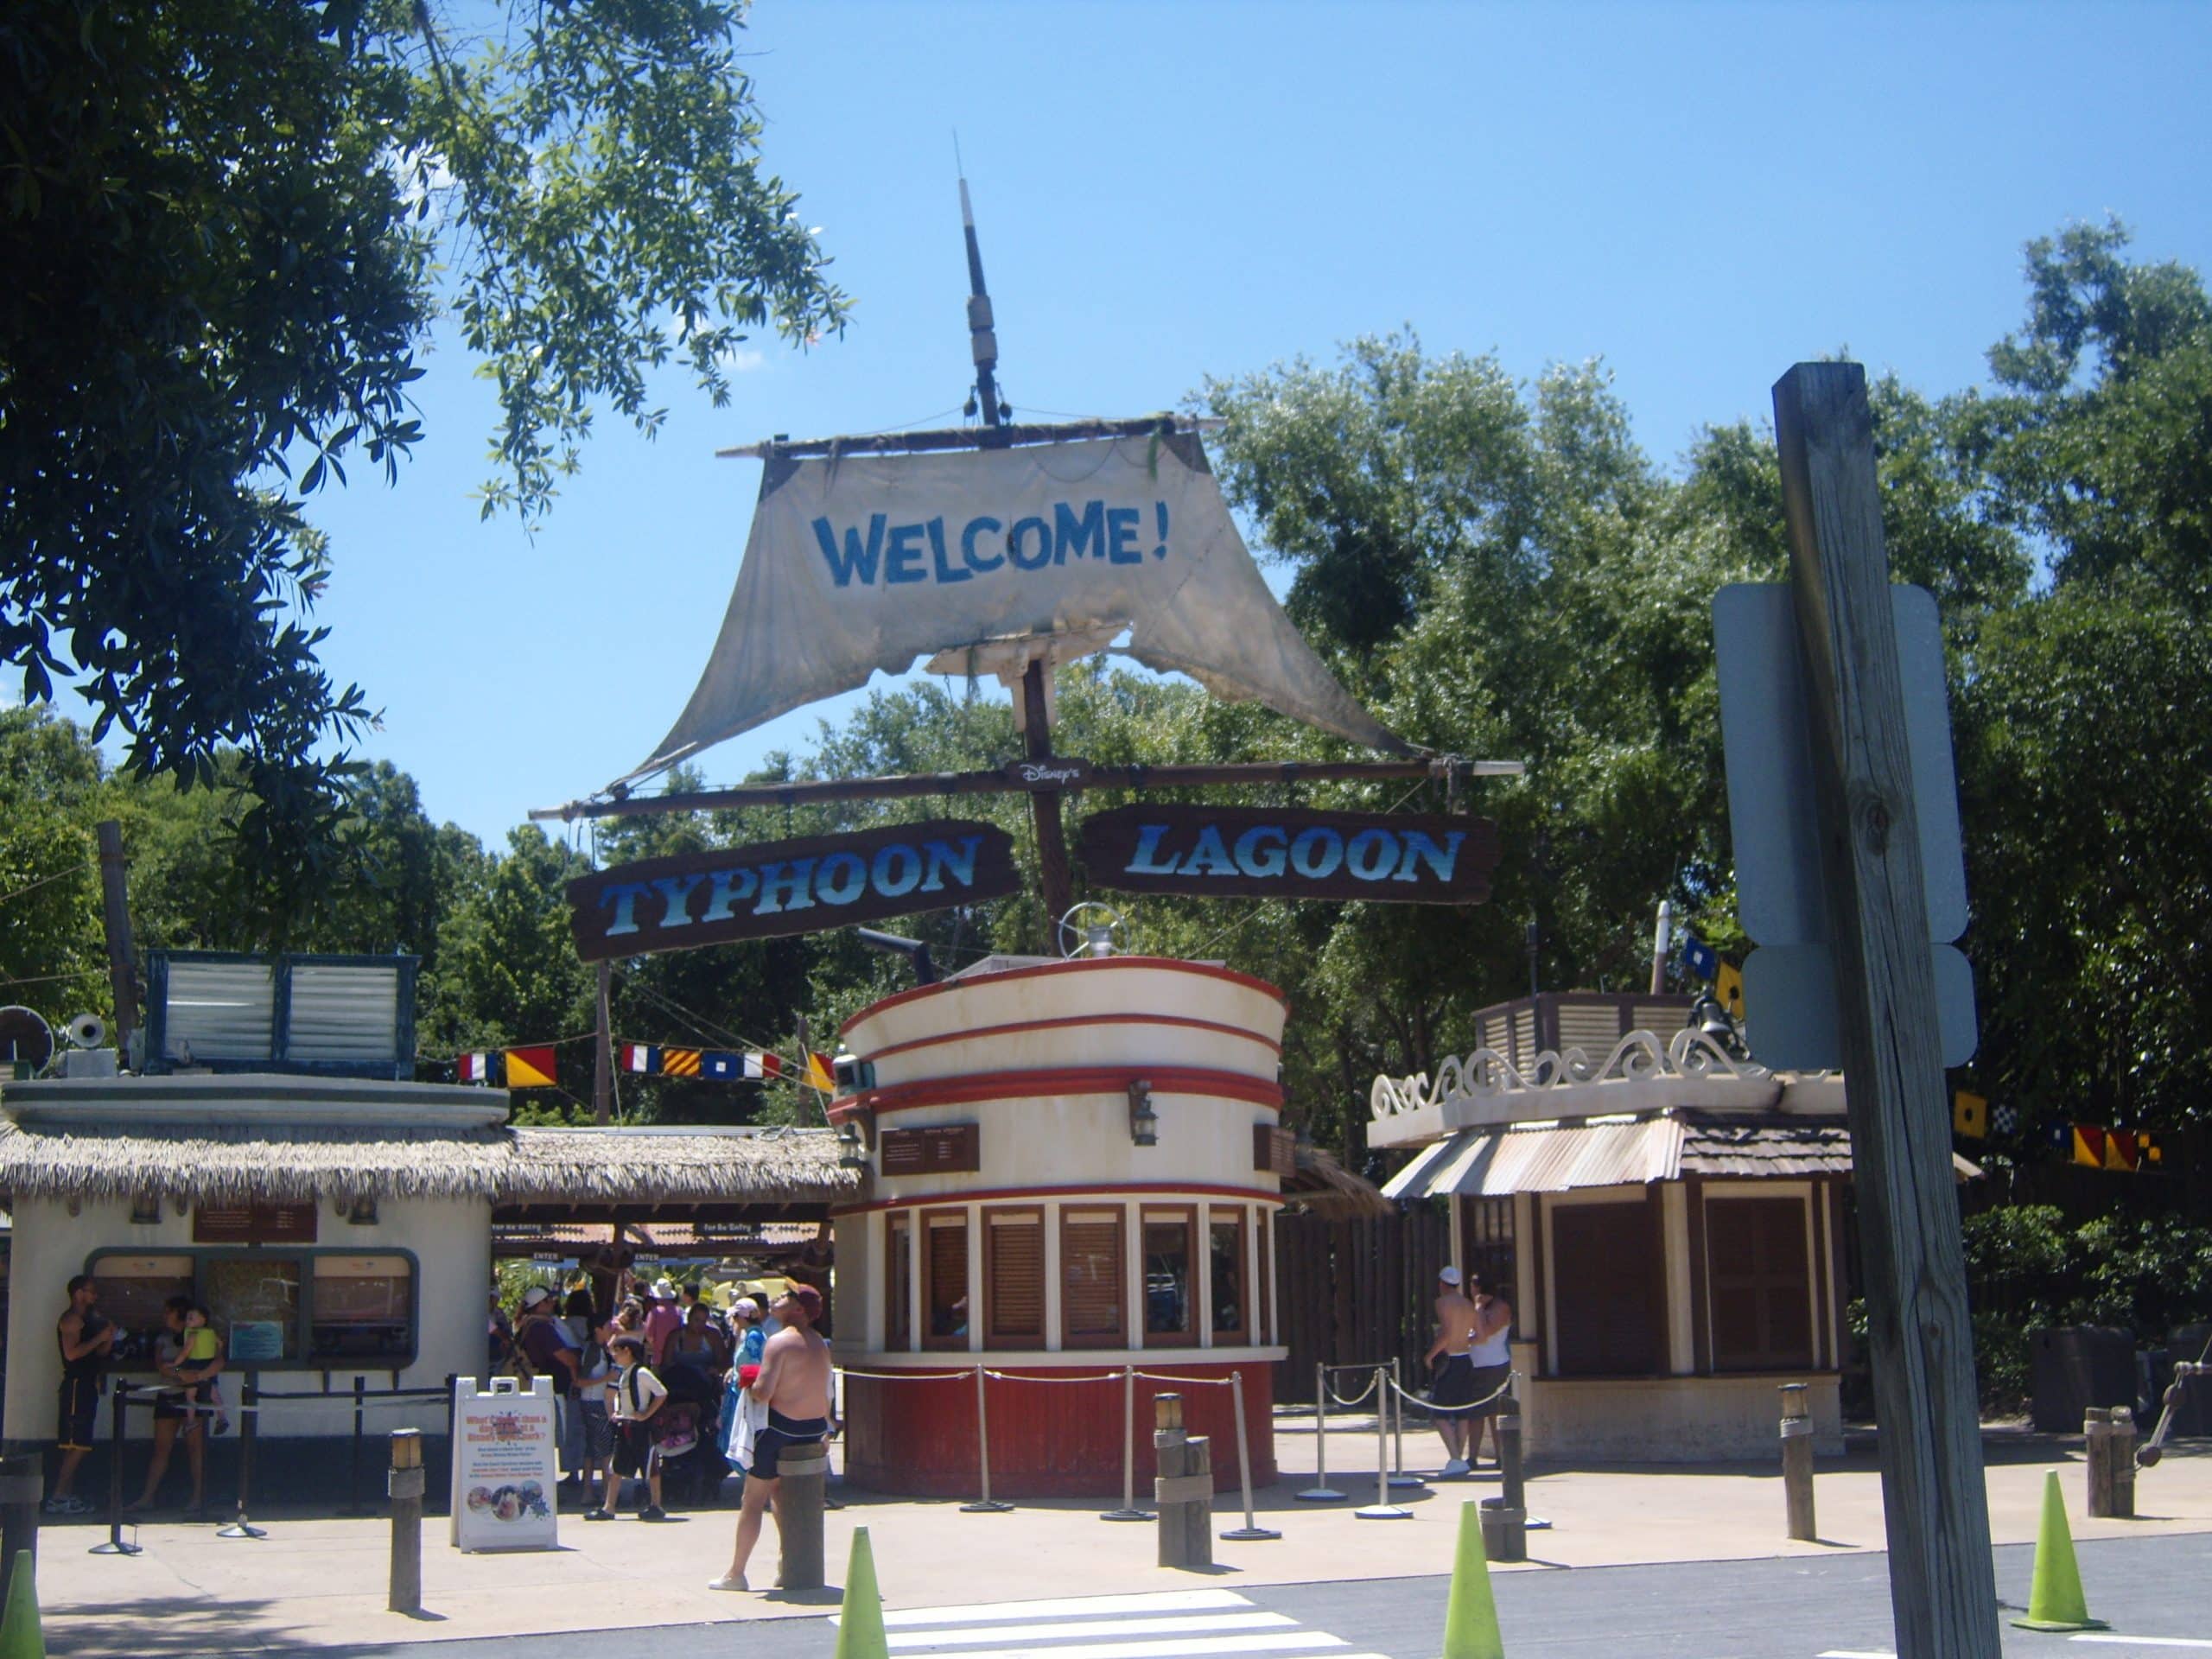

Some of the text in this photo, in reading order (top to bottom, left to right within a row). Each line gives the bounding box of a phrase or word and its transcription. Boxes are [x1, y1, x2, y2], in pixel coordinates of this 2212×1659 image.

[810, 499, 1170, 588] WELCOME!
[1019, 764, 1079, 785] Disney's
[1123, 824, 1467, 883] LAGOON
[600, 836, 983, 936] TYPHOON
[533, 1251, 559, 1260] ENTER
[634, 1253, 659, 1262] ENTER
